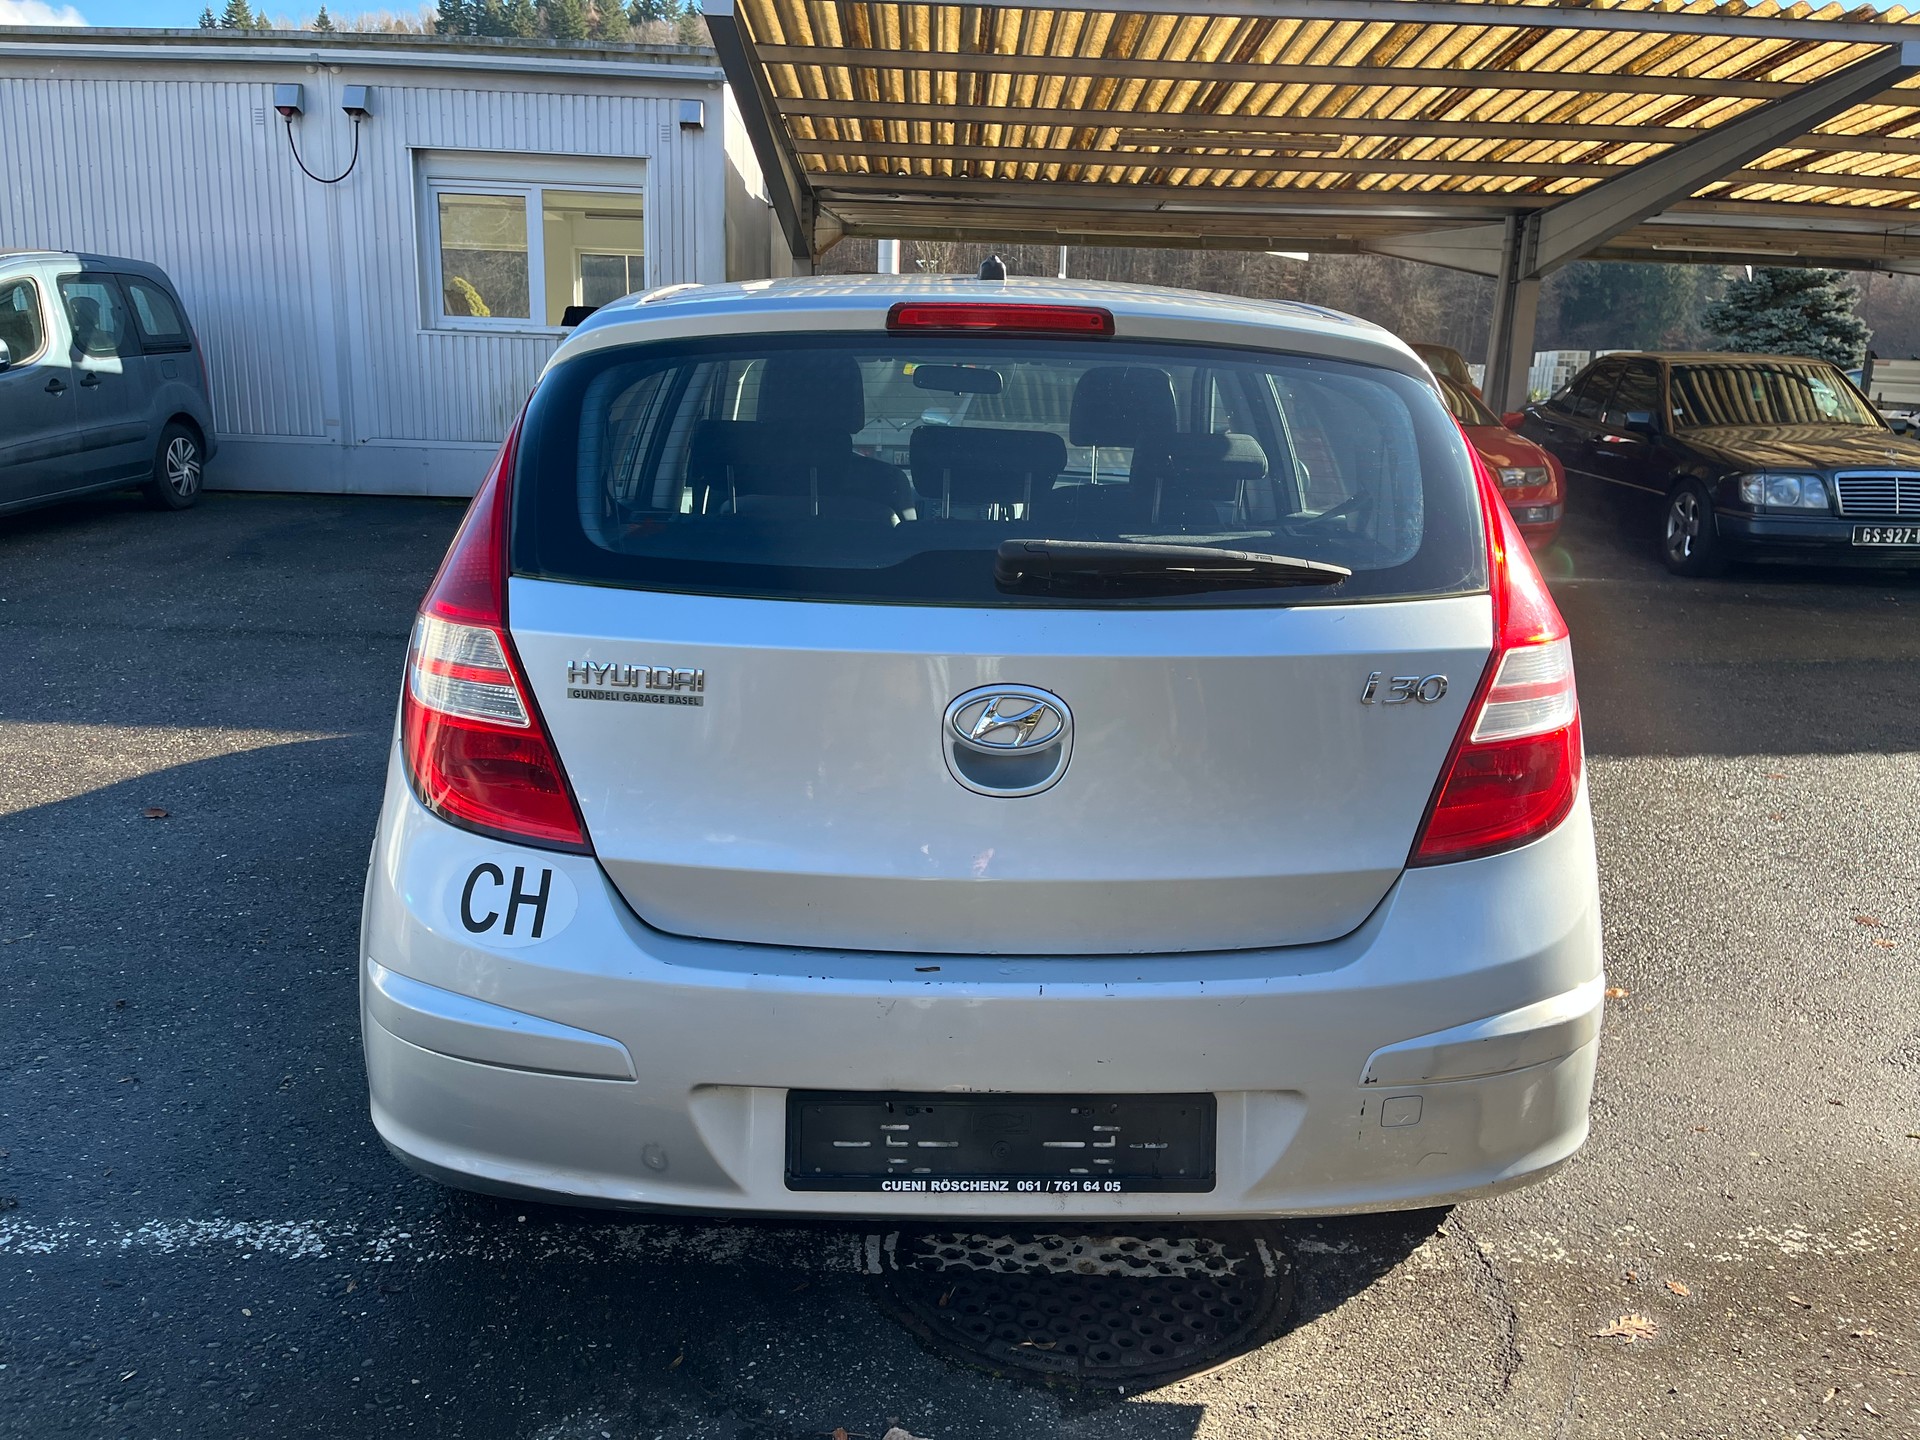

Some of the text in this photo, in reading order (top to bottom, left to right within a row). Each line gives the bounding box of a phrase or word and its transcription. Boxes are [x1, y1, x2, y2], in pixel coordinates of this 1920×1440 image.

[567, 660, 705, 692] HYUNDAI
[572, 688, 700, 706] GUNDELI GARAGE BASEL
[460, 862, 552, 938] CH
[881, 1180, 927, 1192] CUENI
[930, 1178, 1010, 1192] RÖSCHENZ
[1016, 1181, 1041, 1192] 061
[1053, 1181, 1078, 1192] 761
[1083, 1181, 1101, 1192] 64
[1103, 1181, 1122, 1192] 05
